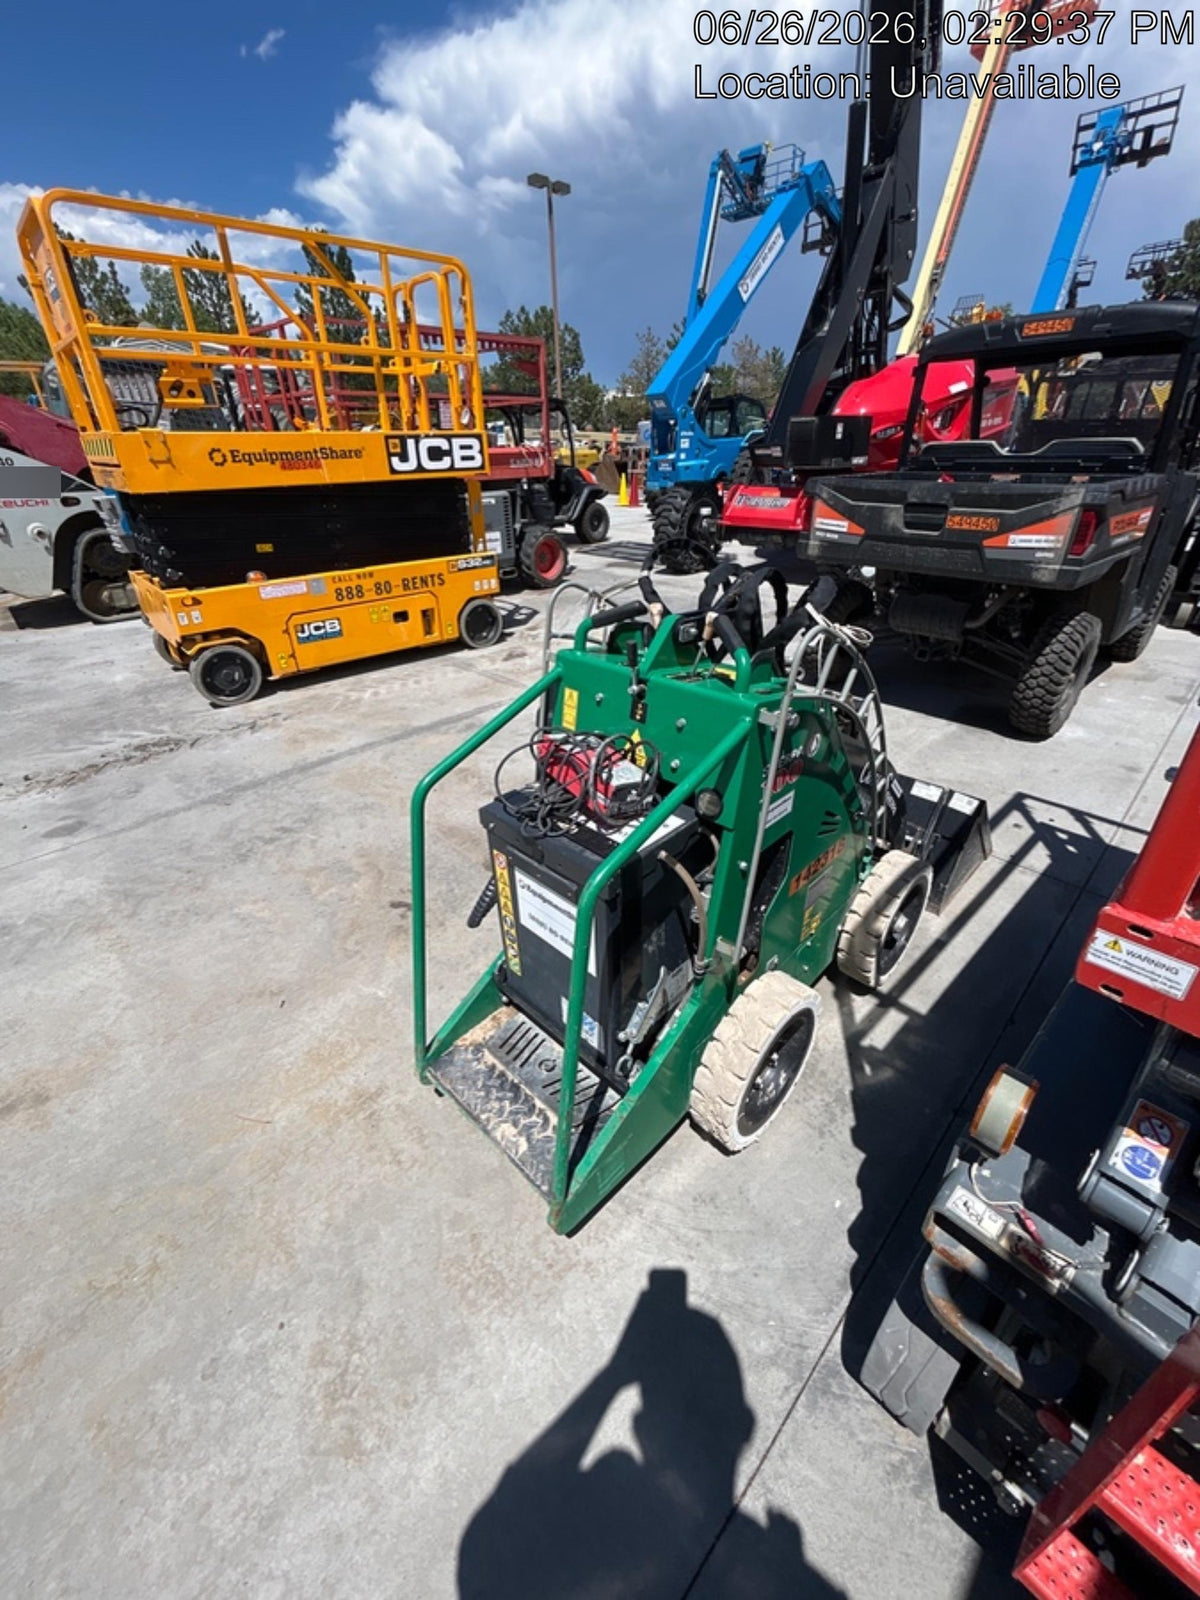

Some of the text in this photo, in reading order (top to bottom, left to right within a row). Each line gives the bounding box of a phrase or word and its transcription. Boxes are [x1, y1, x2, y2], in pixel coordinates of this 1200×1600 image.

[230, 447, 363, 466] EquipmentShare
[390, 438, 483, 472] JCB
[332, 571, 375, 584] CALL NOW
[334, 573, 446, 601] 888-80-RENTS
[297, 619, 341, 638] JCB
[1125, 949, 1181, 976] WARNING
